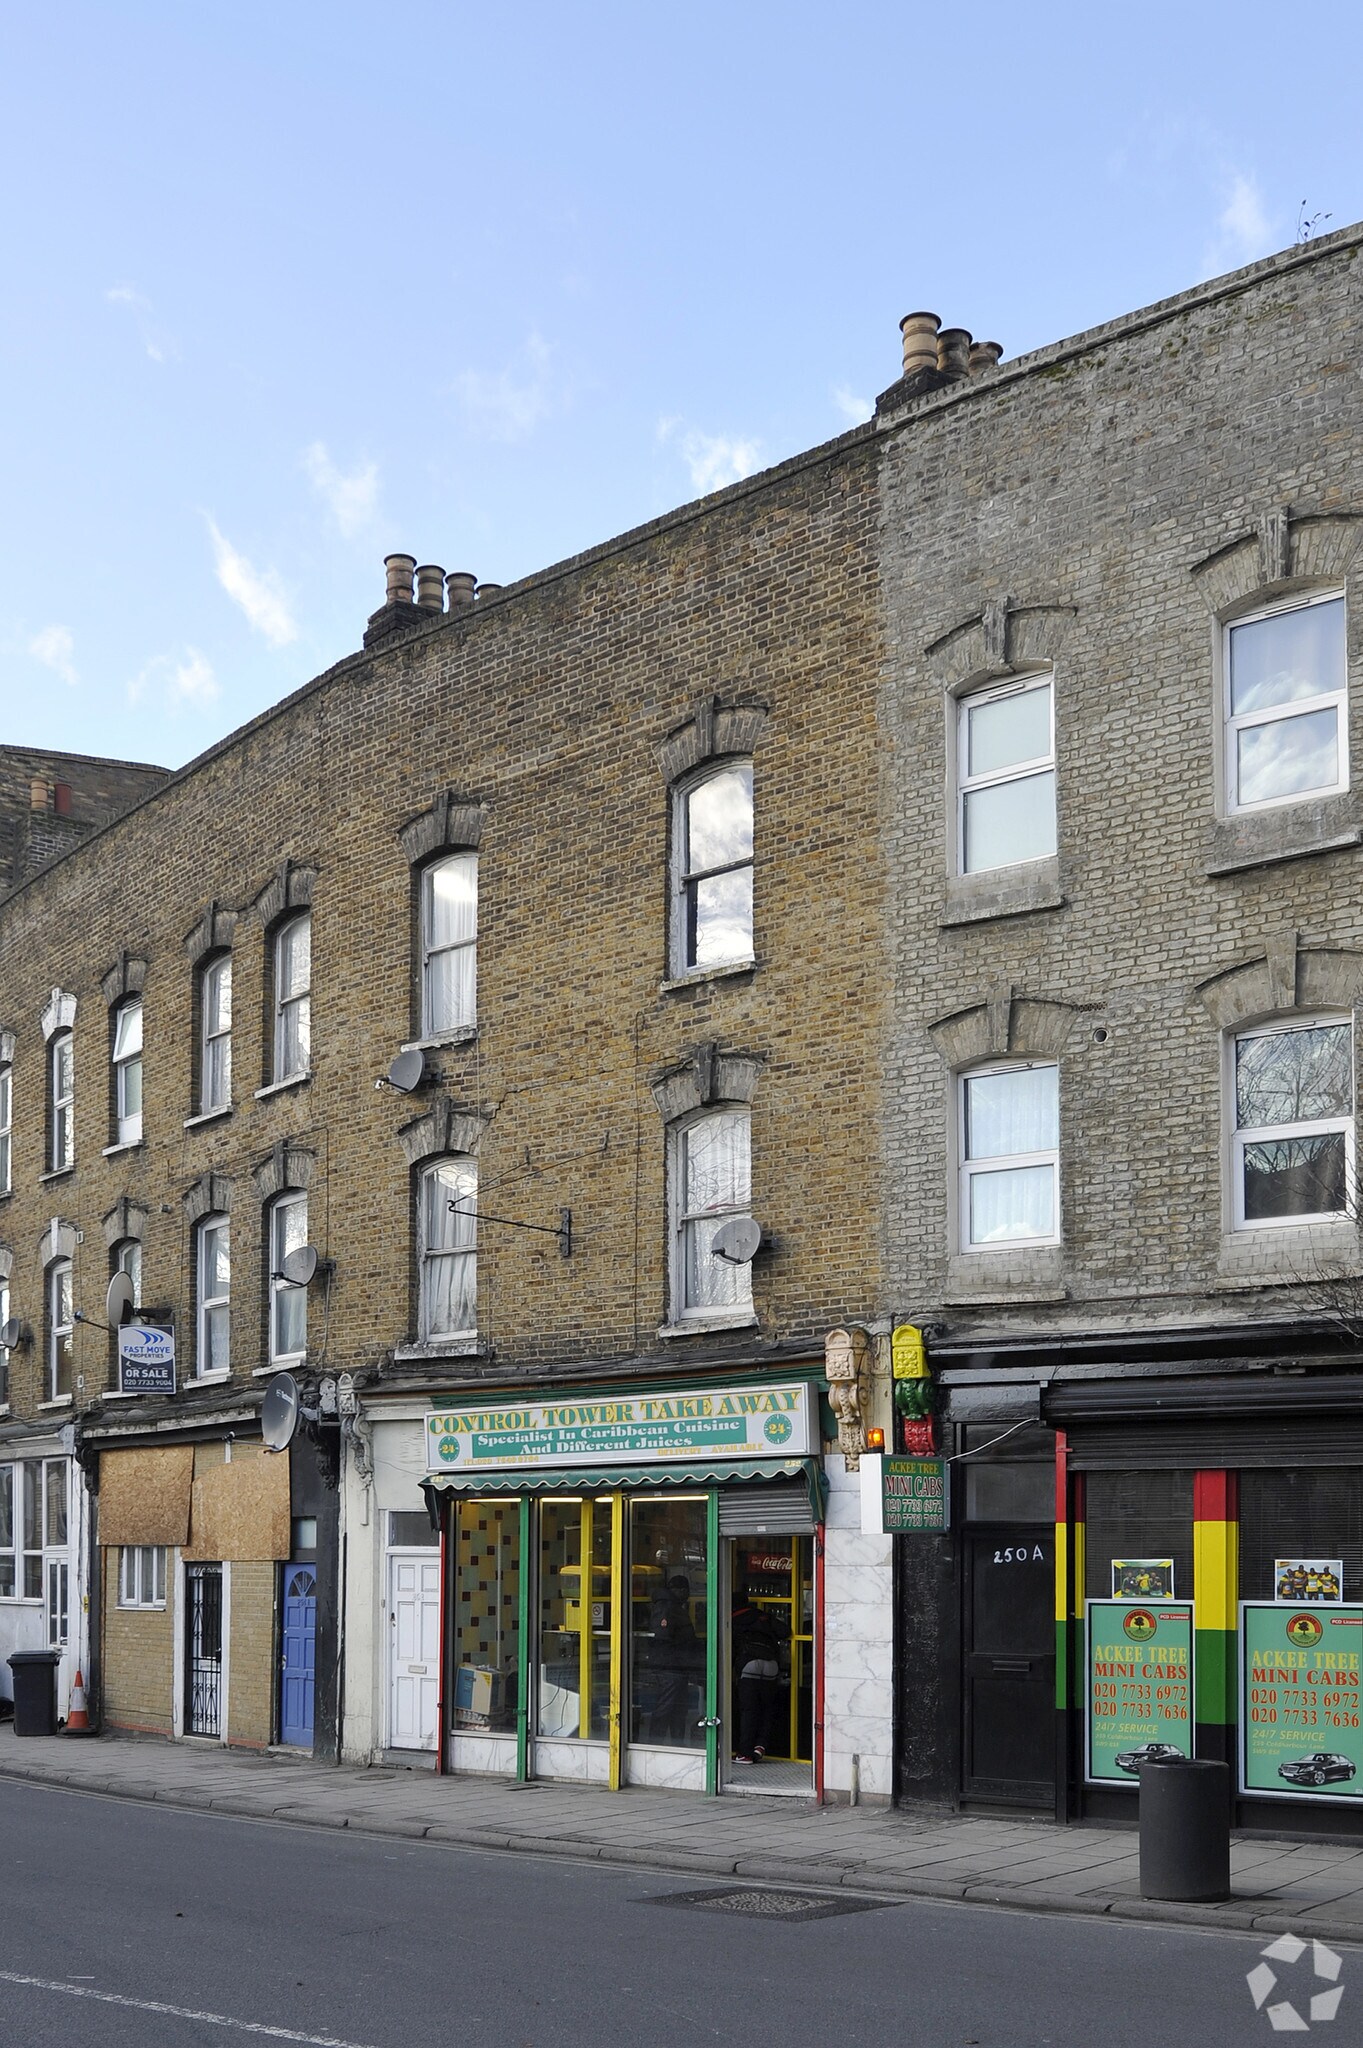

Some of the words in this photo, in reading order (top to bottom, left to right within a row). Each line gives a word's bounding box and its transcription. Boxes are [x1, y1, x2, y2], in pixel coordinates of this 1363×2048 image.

[126, 1369, 140, 1378] OR
[142, 1369, 168, 1378] SALE
[430, 1411, 538, 1434] CONTROL
[542, 1403, 634, 1428] TOWER
[640, 1396, 713, 1421] TAKE
[718, 1390, 801, 1416] AWAY
[478, 1429, 553, 1446] Specialist
[559, 1428, 576, 1440] In
[581, 1423, 668, 1439] Caribbean
[674, 1420, 740, 1434] Cuisine
[769, 1423, 786, 1434] 24
[442, 1444, 456, 1454] 24
[520, 1442, 552, 1455] And
[556, 1439, 630, 1453] Different
[636, 1436, 692, 1448] Juices
[657, 1447, 701, 1456] DELIVERY
[712, 1443, 763, 1453] AVAILABLE
[889, 1461, 916, 1473] ACKEE
[918, 1463, 939, 1474] TREE
[884, 1475, 913, 1497] MINI
[914, 1476, 944, 1498] CABS
[885, 1498, 901, 1512] 020
[902, 1499, 923, 1512] 7733
[924, 1500, 943, 1513] 6972
[885, 1513, 901, 1527] 020
[902, 1514, 923, 1527] 7733
[1095, 1645, 1143, 1662] ACKEE
[1148, 1647, 1187, 1664] TREE
[1252, 1650, 1308, 1668] ACKEE
[1314, 1652, 1359, 1670] TREE
[1095, 1662, 1135, 1678] MINI
[1142, 1664, 1187, 1680] CABS
[1252, 1668, 1298, 1684] MINI
[1306, 1670, 1360, 1686] CABS
[1094, 1683, 1117, 1698] 020
[1122, 1684, 1151, 1699] 7733
[1156, 1685, 1187, 1701] 6972
[1251, 1689, 1277, 1704] 020
[1284, 1690, 1317, 1706] 7733
[1323, 1692, 1359, 1708] 6972
[1094, 1701, 1117, 1716] 020
[1122, 1703, 1152, 1718] 7733
[1157, 1704, 1187, 1720] 7636
[1251, 1708, 1277, 1723] 020
[1284, 1709, 1318, 1725] 7733
[1324, 1711, 1359, 1728] 7636
[1095, 1722, 1116, 1731] 24/7
[1118, 1723, 1158, 1734] SERVICE
[1253, 1729, 1276, 1739] 24/7
[1280, 1731, 1326, 1742] SERVICE
